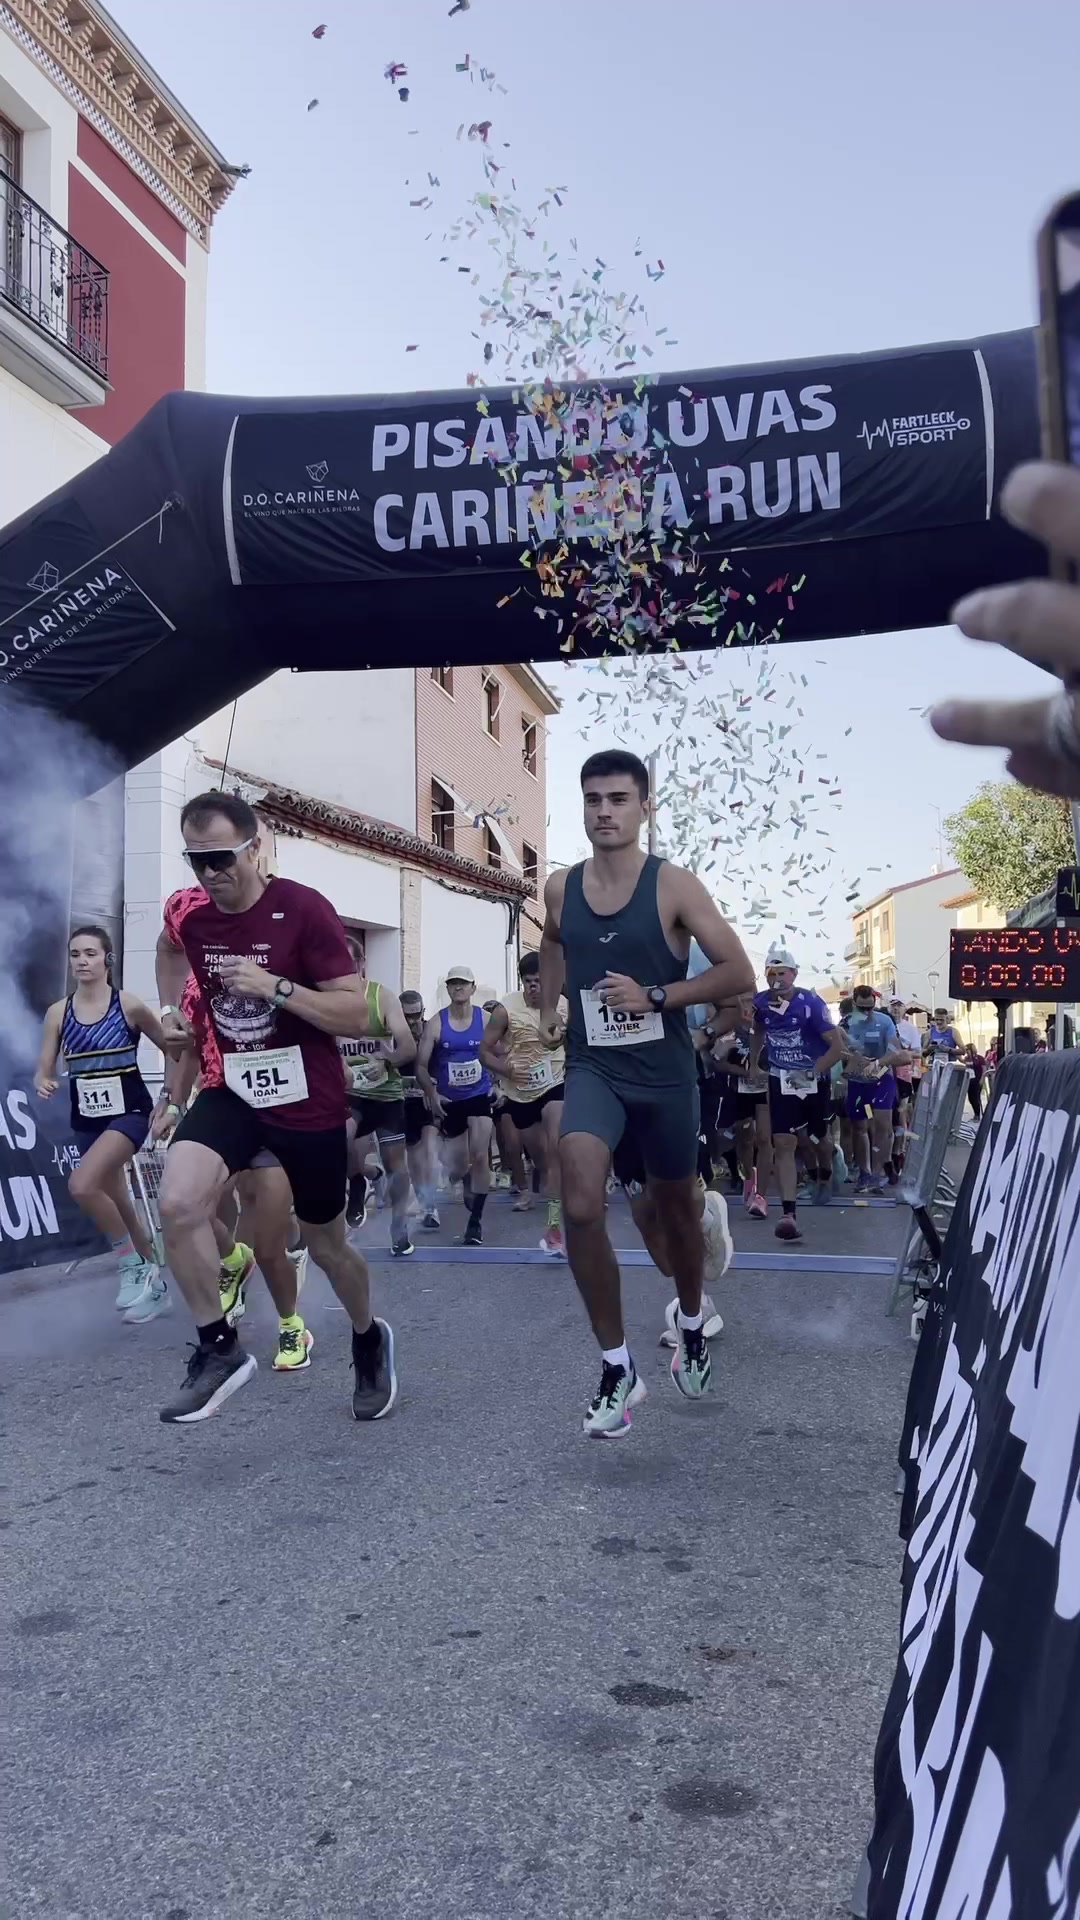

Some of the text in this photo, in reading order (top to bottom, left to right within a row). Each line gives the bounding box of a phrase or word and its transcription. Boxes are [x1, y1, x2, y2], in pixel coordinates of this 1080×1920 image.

[371, 384, 837, 472] PISANDO UVAS
[892, 410, 955, 430] FARTLECK
[897, 427, 957, 446] SPORT
[243, 493, 272, 506] D.O.
[331, 505, 361, 513] PIEDRAS
[373, 451, 841, 552] CARIÑENA RUN
[1, 584, 133, 684] VINO QUE NACE DE LAS PIEDRAS
[604, 1022, 640, 1032] JAVIER
[241, 1067, 289, 1090] 15L
[451, 1067, 477, 1078] 1414
[253, 1087, 278, 1098] IOAN
